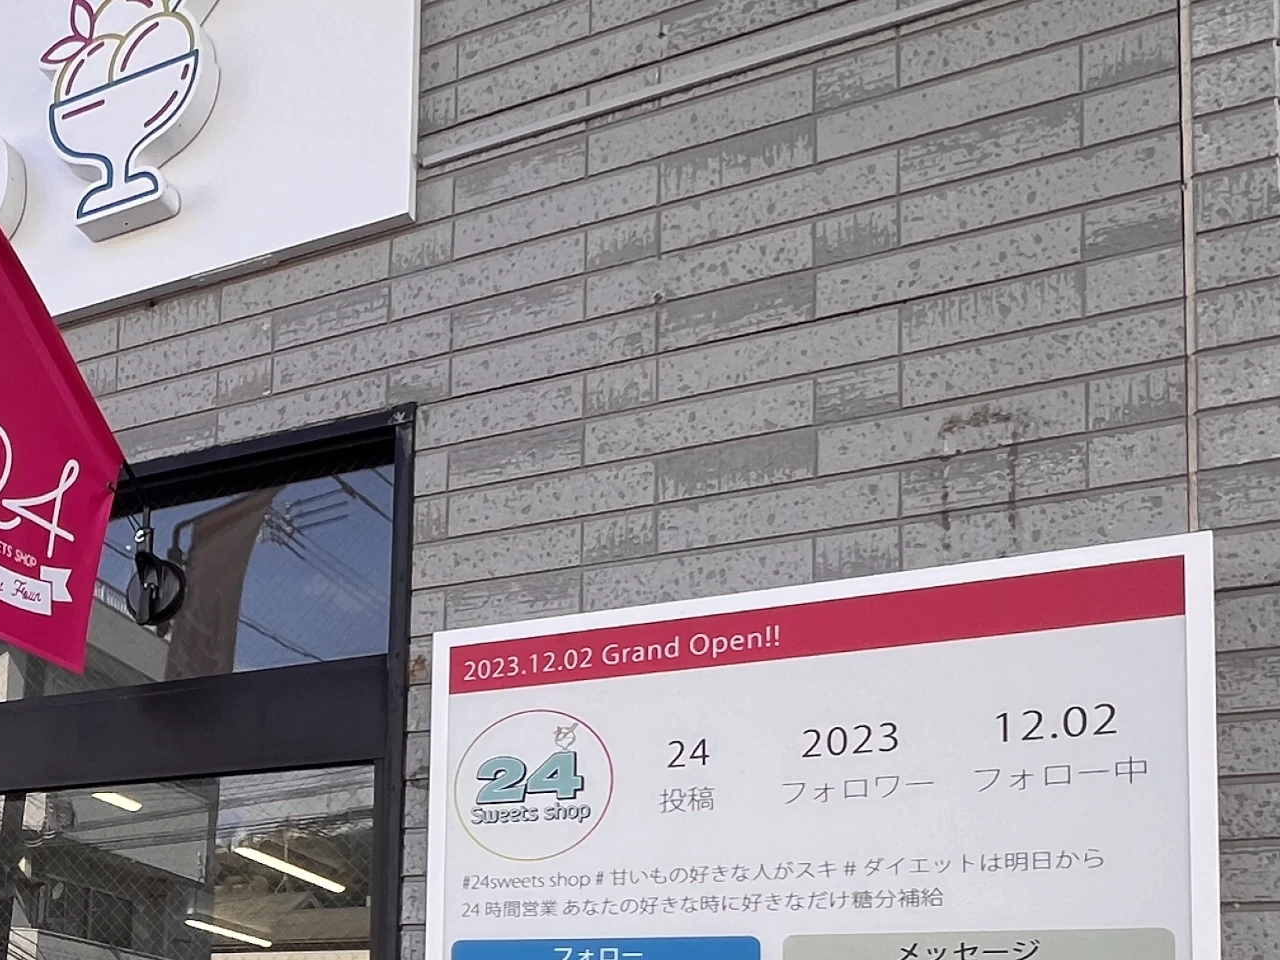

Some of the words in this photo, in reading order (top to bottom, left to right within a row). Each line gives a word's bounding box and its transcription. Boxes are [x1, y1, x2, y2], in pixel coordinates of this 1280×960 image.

[14, 548, 38, 568] SHOP
[11, 578, 43, 603] Four
[463, 649, 593, 681] 2023.12.02
[601, 636, 680, 666] Grand
[689, 625, 781, 658] Open!!
[996, 703, 1118, 743] 12.02
[666, 738, 710, 768] 24
[801, 722, 899, 759] 2023
[475, 750, 585, 805] 24
[973, 755, 1148, 792] フォロー中
[659, 786, 715, 814] 投稿
[781, 775, 935, 804] フォロワー
[469, 805, 539, 825] Sweets
[543, 800, 591, 823] shop
[462, 872, 545, 891] #24sweets
[550, 872, 591, 890] shop
